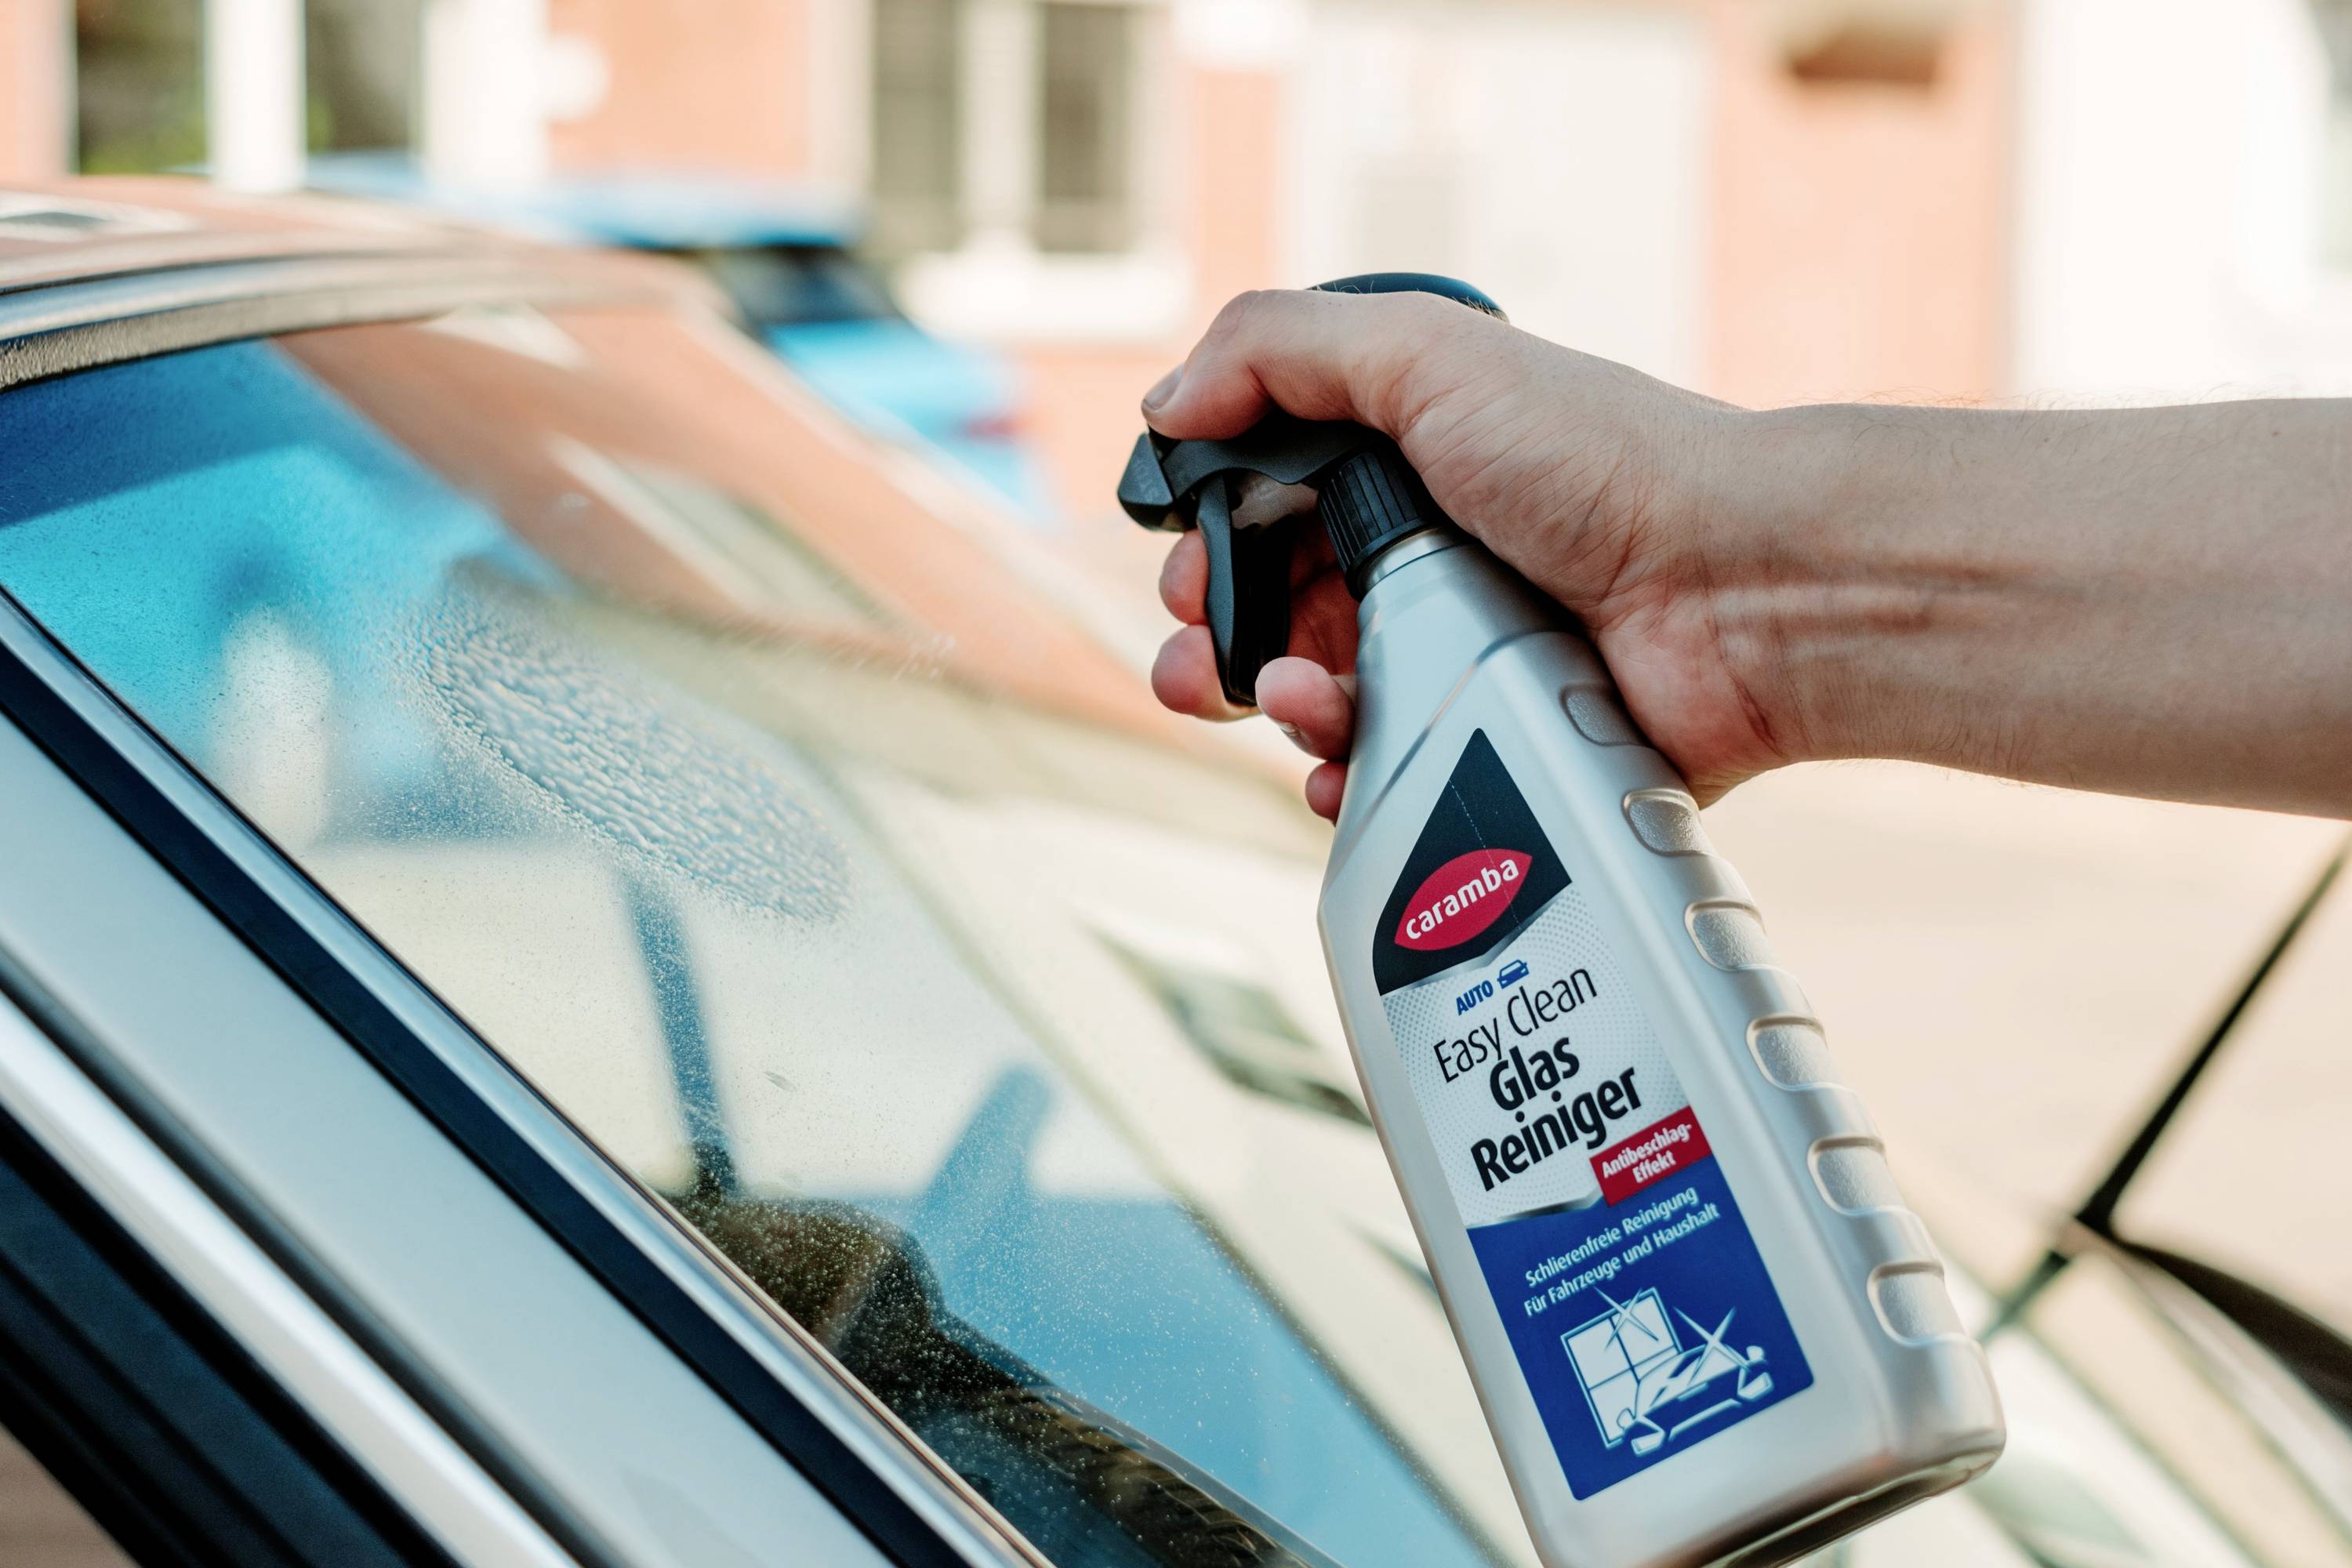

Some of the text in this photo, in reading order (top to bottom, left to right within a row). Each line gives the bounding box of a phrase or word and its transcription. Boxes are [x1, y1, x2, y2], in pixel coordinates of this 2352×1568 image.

[1406, 858, 1519, 939] caramba
[1433, 968, 1597, 1083] Easy Clean
[1455, 979, 1494, 1015] AUTO
[1490, 1036, 1580, 1111] Glas
[1470, 1067, 1642, 1192] Reiniger
[1601, 1122, 1693, 1178] Antibeschlag-
[1632, 1149, 1676, 1184] Effekt
[1523, 1202, 1721, 1317] Für Fahrzeuge und Haushalt
[1525, 1187, 1699, 1288] Schlierenfreie Reinigung
